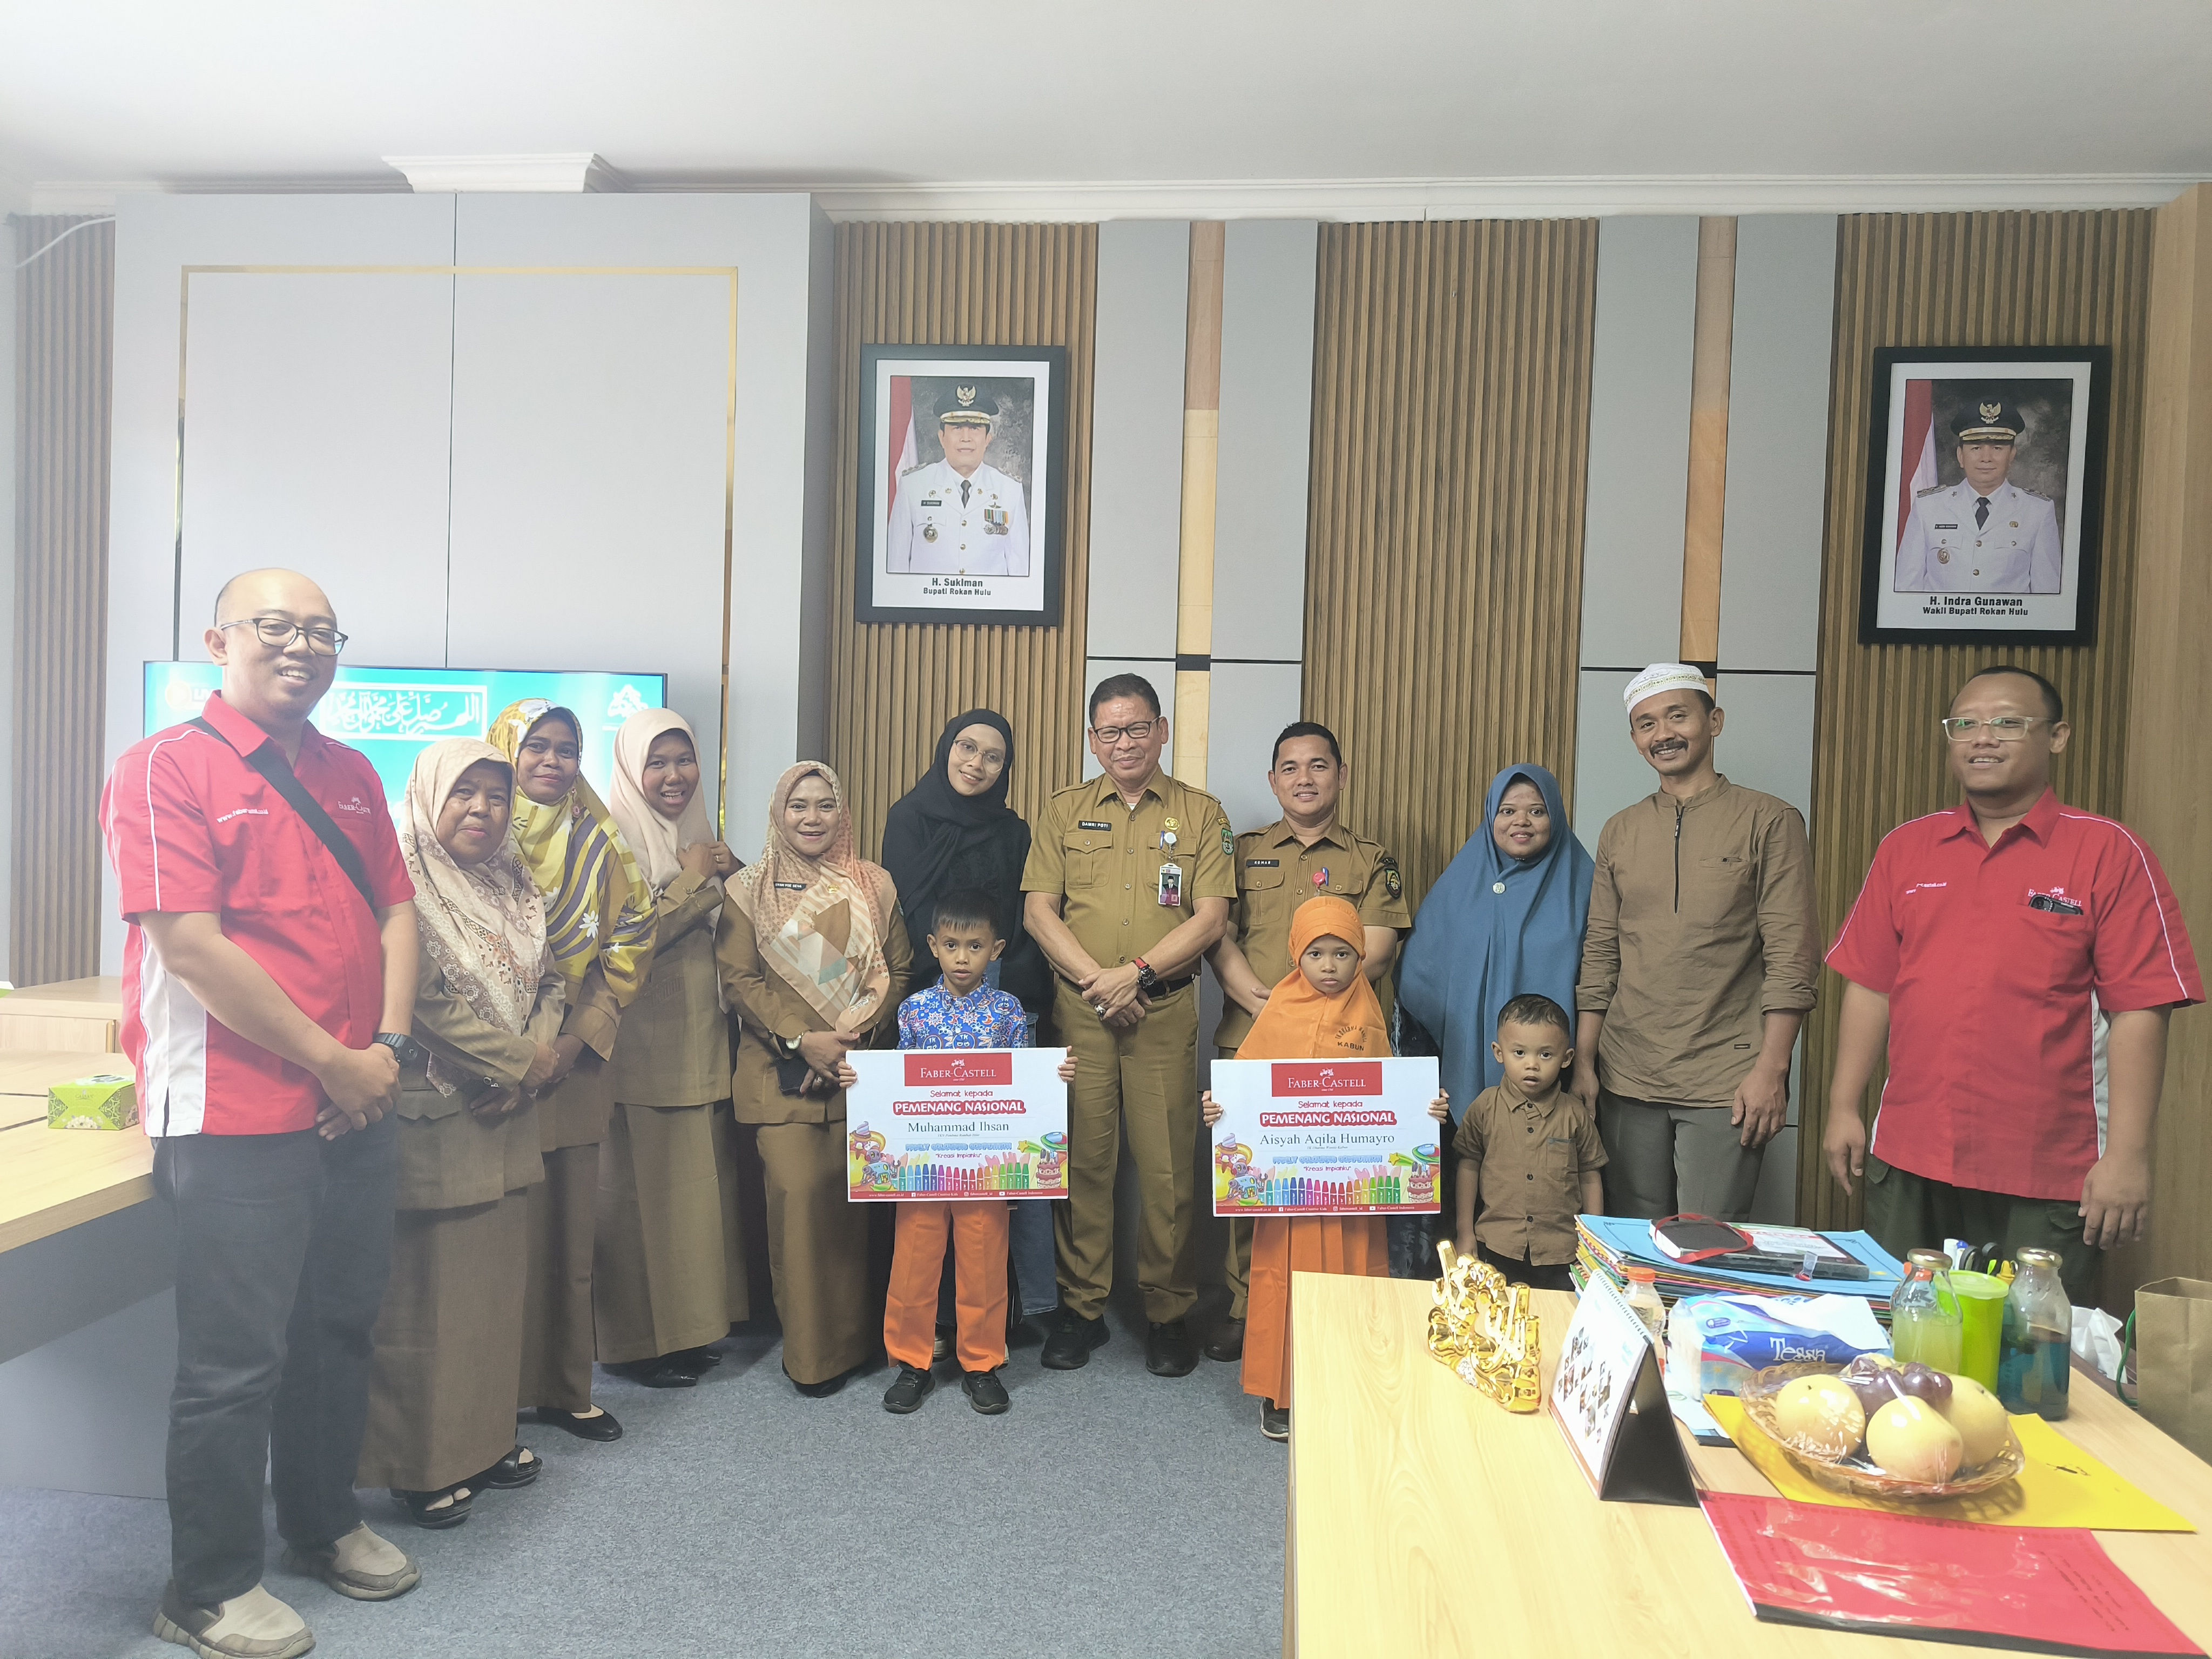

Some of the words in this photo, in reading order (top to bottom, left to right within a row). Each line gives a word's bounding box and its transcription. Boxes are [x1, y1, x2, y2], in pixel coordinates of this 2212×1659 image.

[932, 578, 941, 586] H.
[944, 578, 983, 587] Sukiman
[1930, 596, 1940, 605] H.
[1944, 596, 1971, 605] Indra
[1974, 597, 2022, 606] Gunawan
[1949, 608, 1977, 616] Bupati
[1337, 1041, 1364, 1051] KABUN
[920, 1067, 996, 1077] FABER-CASTELL
[1288, 1076, 1366, 1088] FABER-CASTELL
[965, 1090, 993, 1098] kepada
[895, 1102, 961, 1112] PEMENANG
[965, 1101, 1022, 1112] NASIONAL
[1333, 1100, 1363, 1109] kepada
[1262, 1114, 1330, 1124] PEMENANG
[1334, 1112, 1393, 1123] NASIONAL
[907, 1122, 975, 1132] Muhammad
[979, 1121, 1009, 1131] Ihsan
[1260, 1134, 1300, 1147] Aisyah
[1305, 1133, 1336, 1146] Aqila
[1341, 1133, 1394, 1145] Humayro
[1770, 1337, 1826, 1361] Tessa
